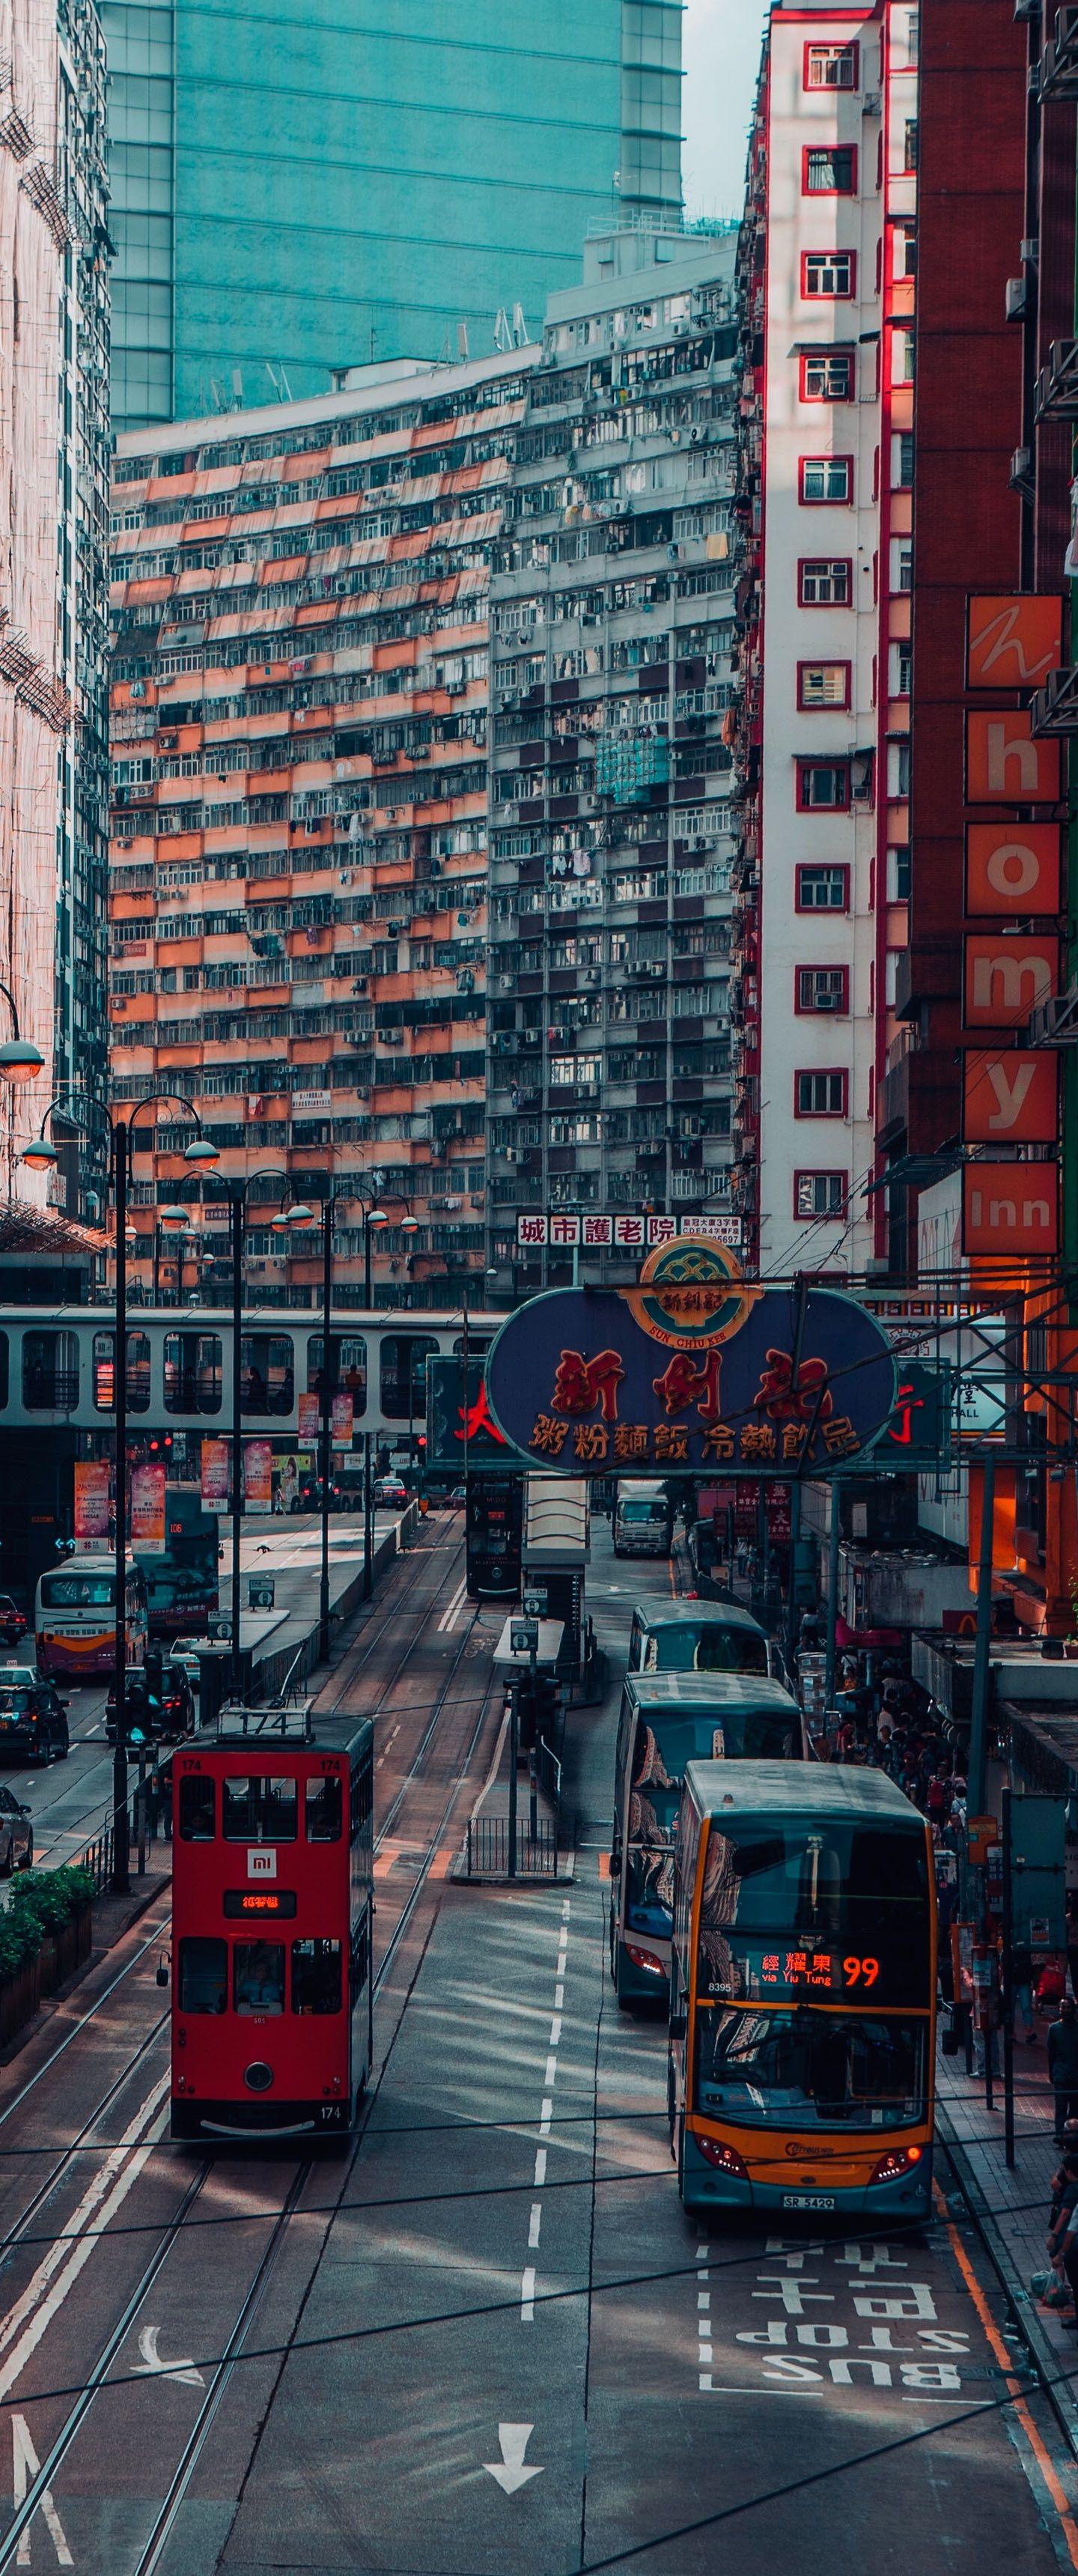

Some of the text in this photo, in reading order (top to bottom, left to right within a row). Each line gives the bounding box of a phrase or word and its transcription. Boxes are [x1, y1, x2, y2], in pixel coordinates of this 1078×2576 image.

[972, 1191, 1050, 1227] Inn
[520, 1218, 674, 1243] 城市護老院
[650, 1325, 726, 1348] SUN CHIU KEE
[951, 1409, 979, 1418] HALL
[240, 1713, 288, 1735] 174
[182, 1761, 201, 1770] 174
[320, 1761, 341, 1770] 174
[762, 1952, 831, 1972] 經耀東
[843, 1957, 879, 1987] 99
[708, 1982, 731, 1992] 8395
[762, 1970, 832, 1987] via Yiu Tung
[321, 2106, 341, 2119] 174
[785, 2197, 832, 2208] SR 5429
[735, 2321, 971, 2353] STOP
[761, 2354, 962, 2390] BUS
